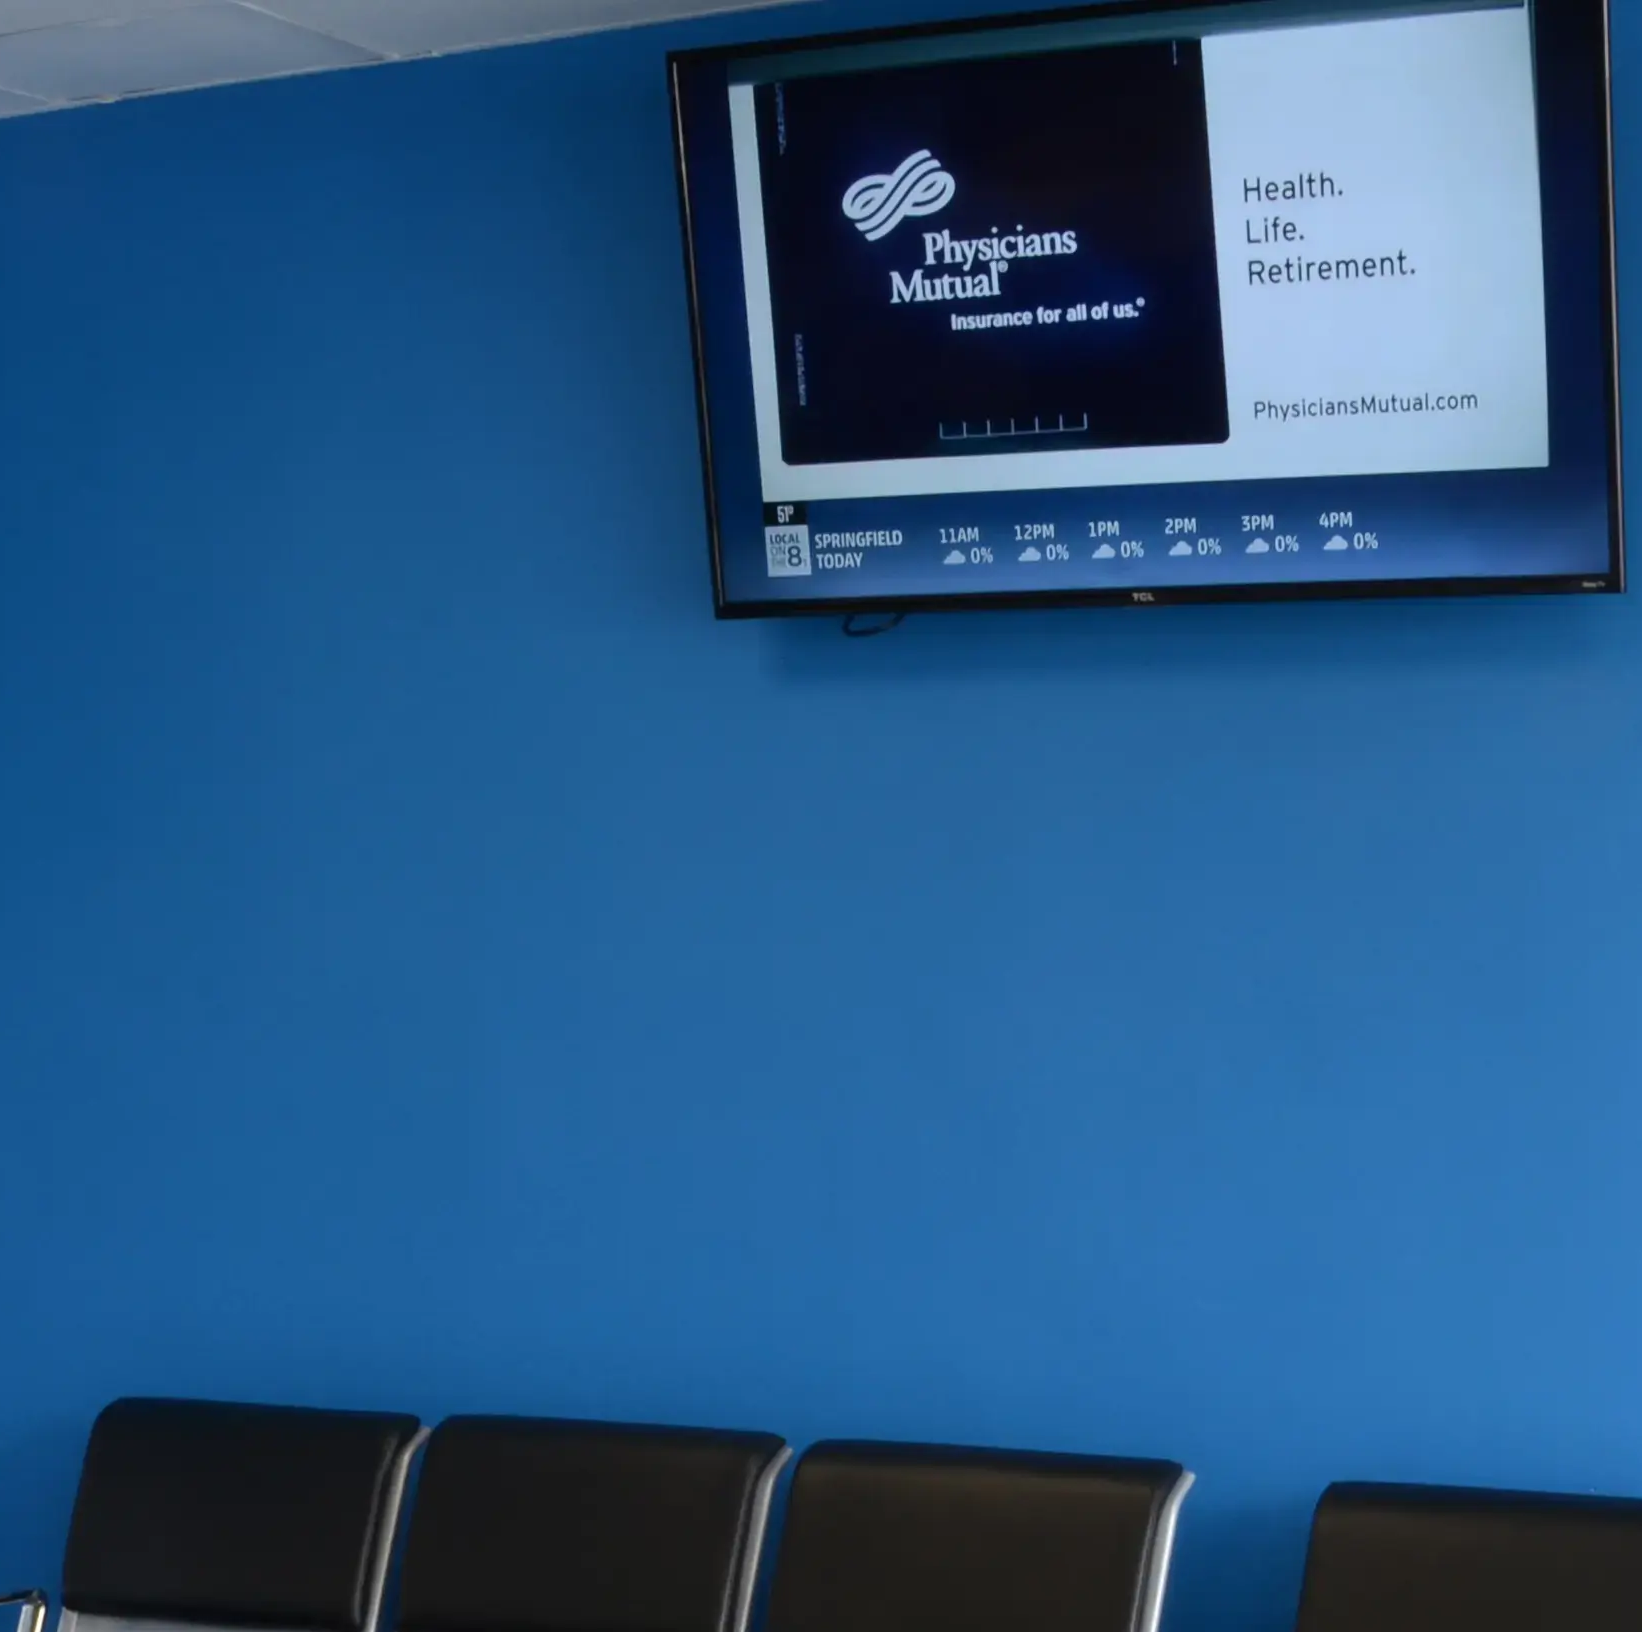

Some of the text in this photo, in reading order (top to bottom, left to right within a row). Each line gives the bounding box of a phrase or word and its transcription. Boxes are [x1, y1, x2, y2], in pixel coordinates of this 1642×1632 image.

[1242, 171, 1344, 204] Health.
[1245, 215, 1305, 244] Life.
[921, 224, 1078, 271] Physicians
[1248, 248, 1416, 286] Retirement.
[950, 310, 1034, 331] Insurance
[1036, 306, 1063, 325] for
[1066, 303, 1088, 323] all
[1090, 302, 1110, 321] of
[1253, 392, 1479, 423] PhysiciansMutual.com
[1088, 521, 1121, 538] 1PM
[1164, 517, 1198, 536] 2PM
[1241, 514, 1276, 533] 3PM
[1318, 511, 1354, 530] 4PM
[769, 533, 801, 546] LOCAL
[814, 529, 904, 550] SPRINGFIELD
[938, 527, 980, 545] 11AM
[1013, 524, 1056, 542] 12PM
[1353, 532, 1379, 551] 0%
[1045, 544, 1070, 561] 0%
[1120, 540, 1145, 559] 0%
[1197, 537, 1223, 556] 0%
[1274, 534, 1300, 553] 0%
[815, 552, 864, 570] TODAY
[969, 547, 995, 565] 0%
